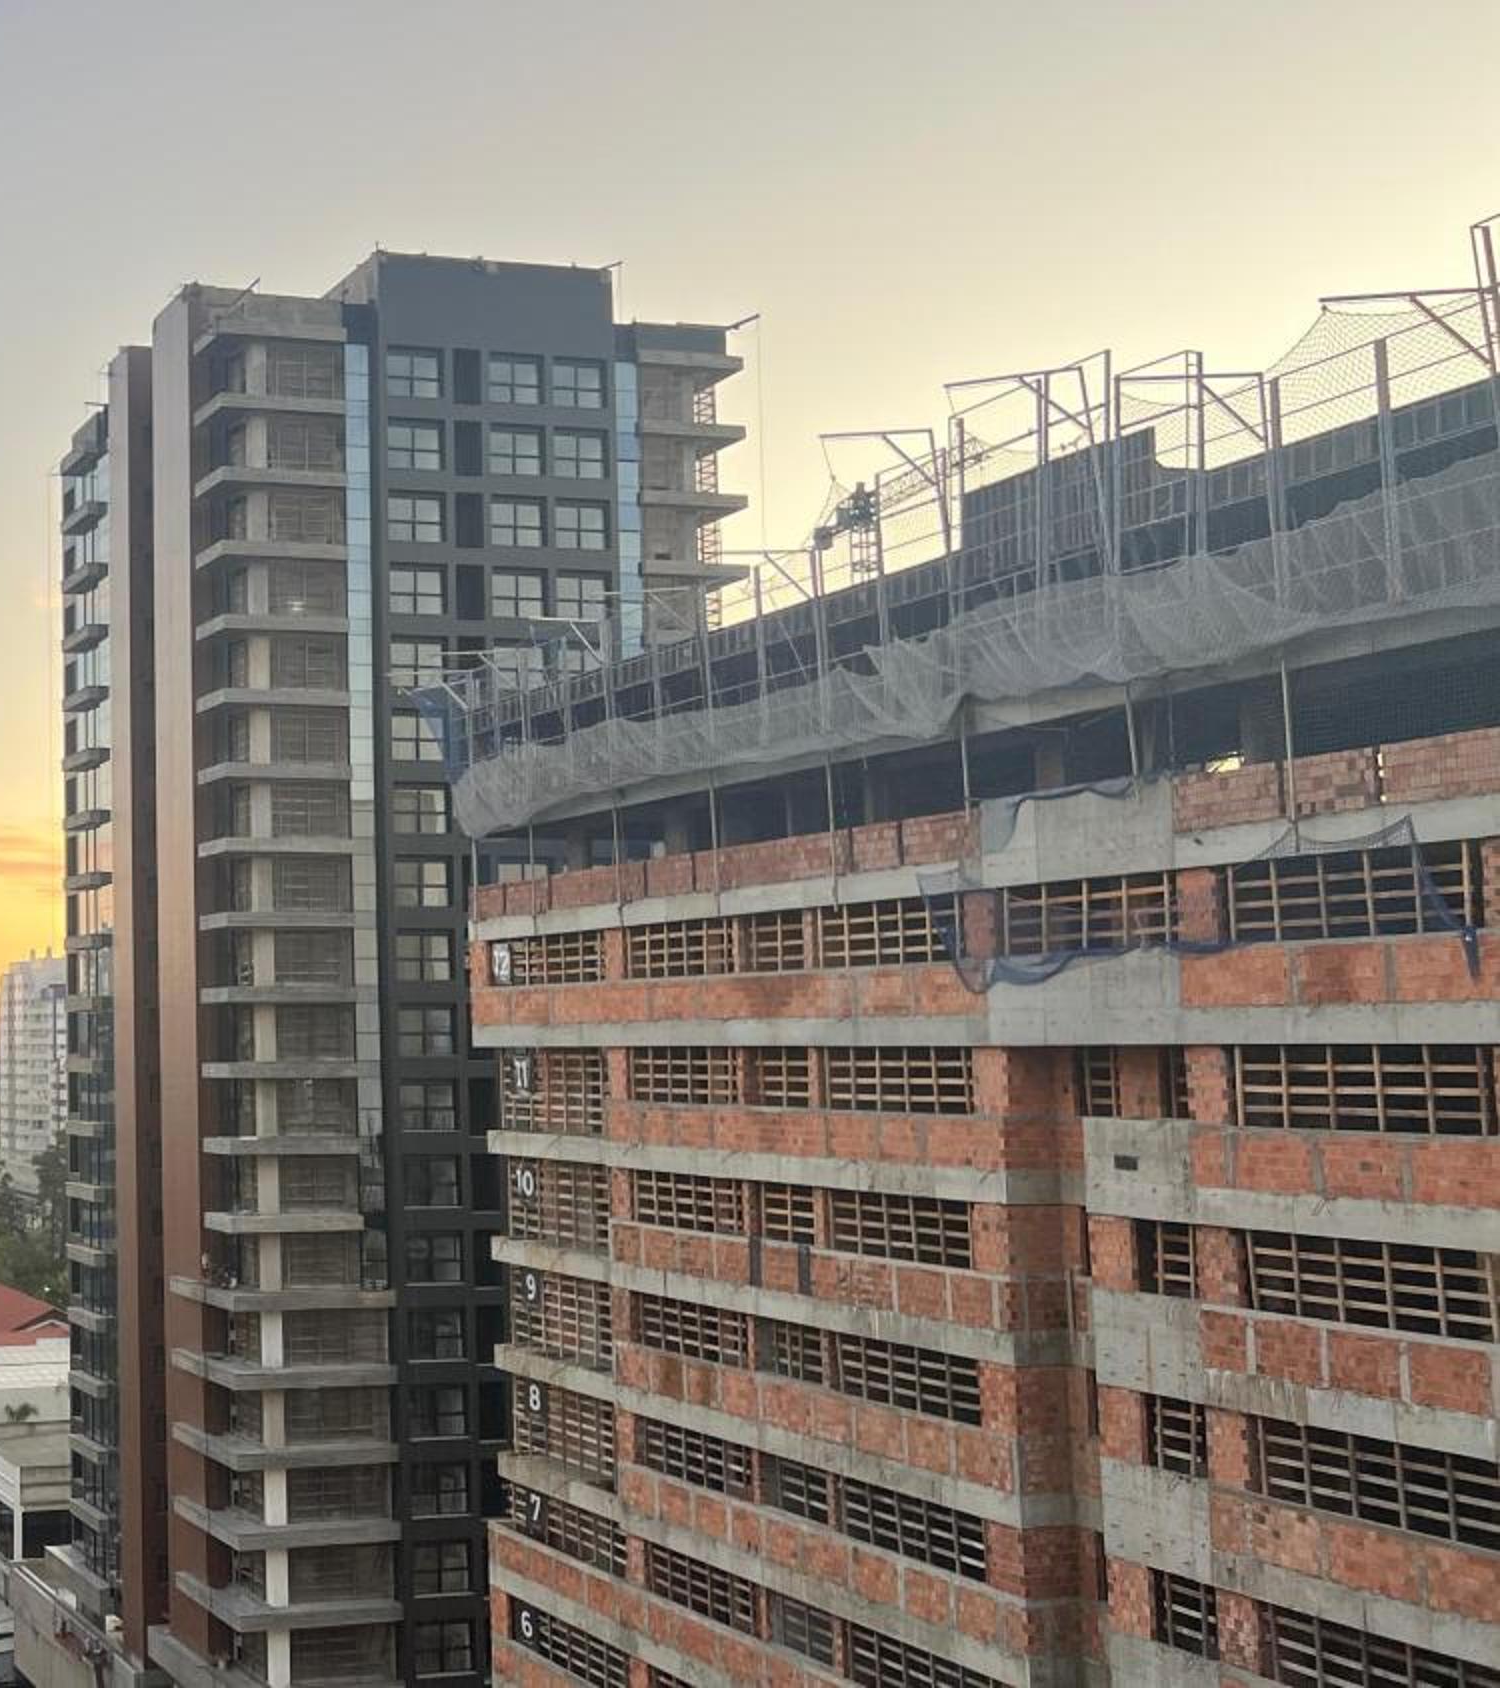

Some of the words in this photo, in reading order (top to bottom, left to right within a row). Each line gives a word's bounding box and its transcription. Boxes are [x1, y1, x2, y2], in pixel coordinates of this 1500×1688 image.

[493, 950, 510, 977] 12
[514, 1060, 528, 1088] 11
[515, 1169, 534, 1196] 10
[526, 1273, 536, 1300] 9
[529, 1384, 541, 1411] 8
[530, 1493, 541, 1520] 7
[521, 1611, 533, 1638] 6
